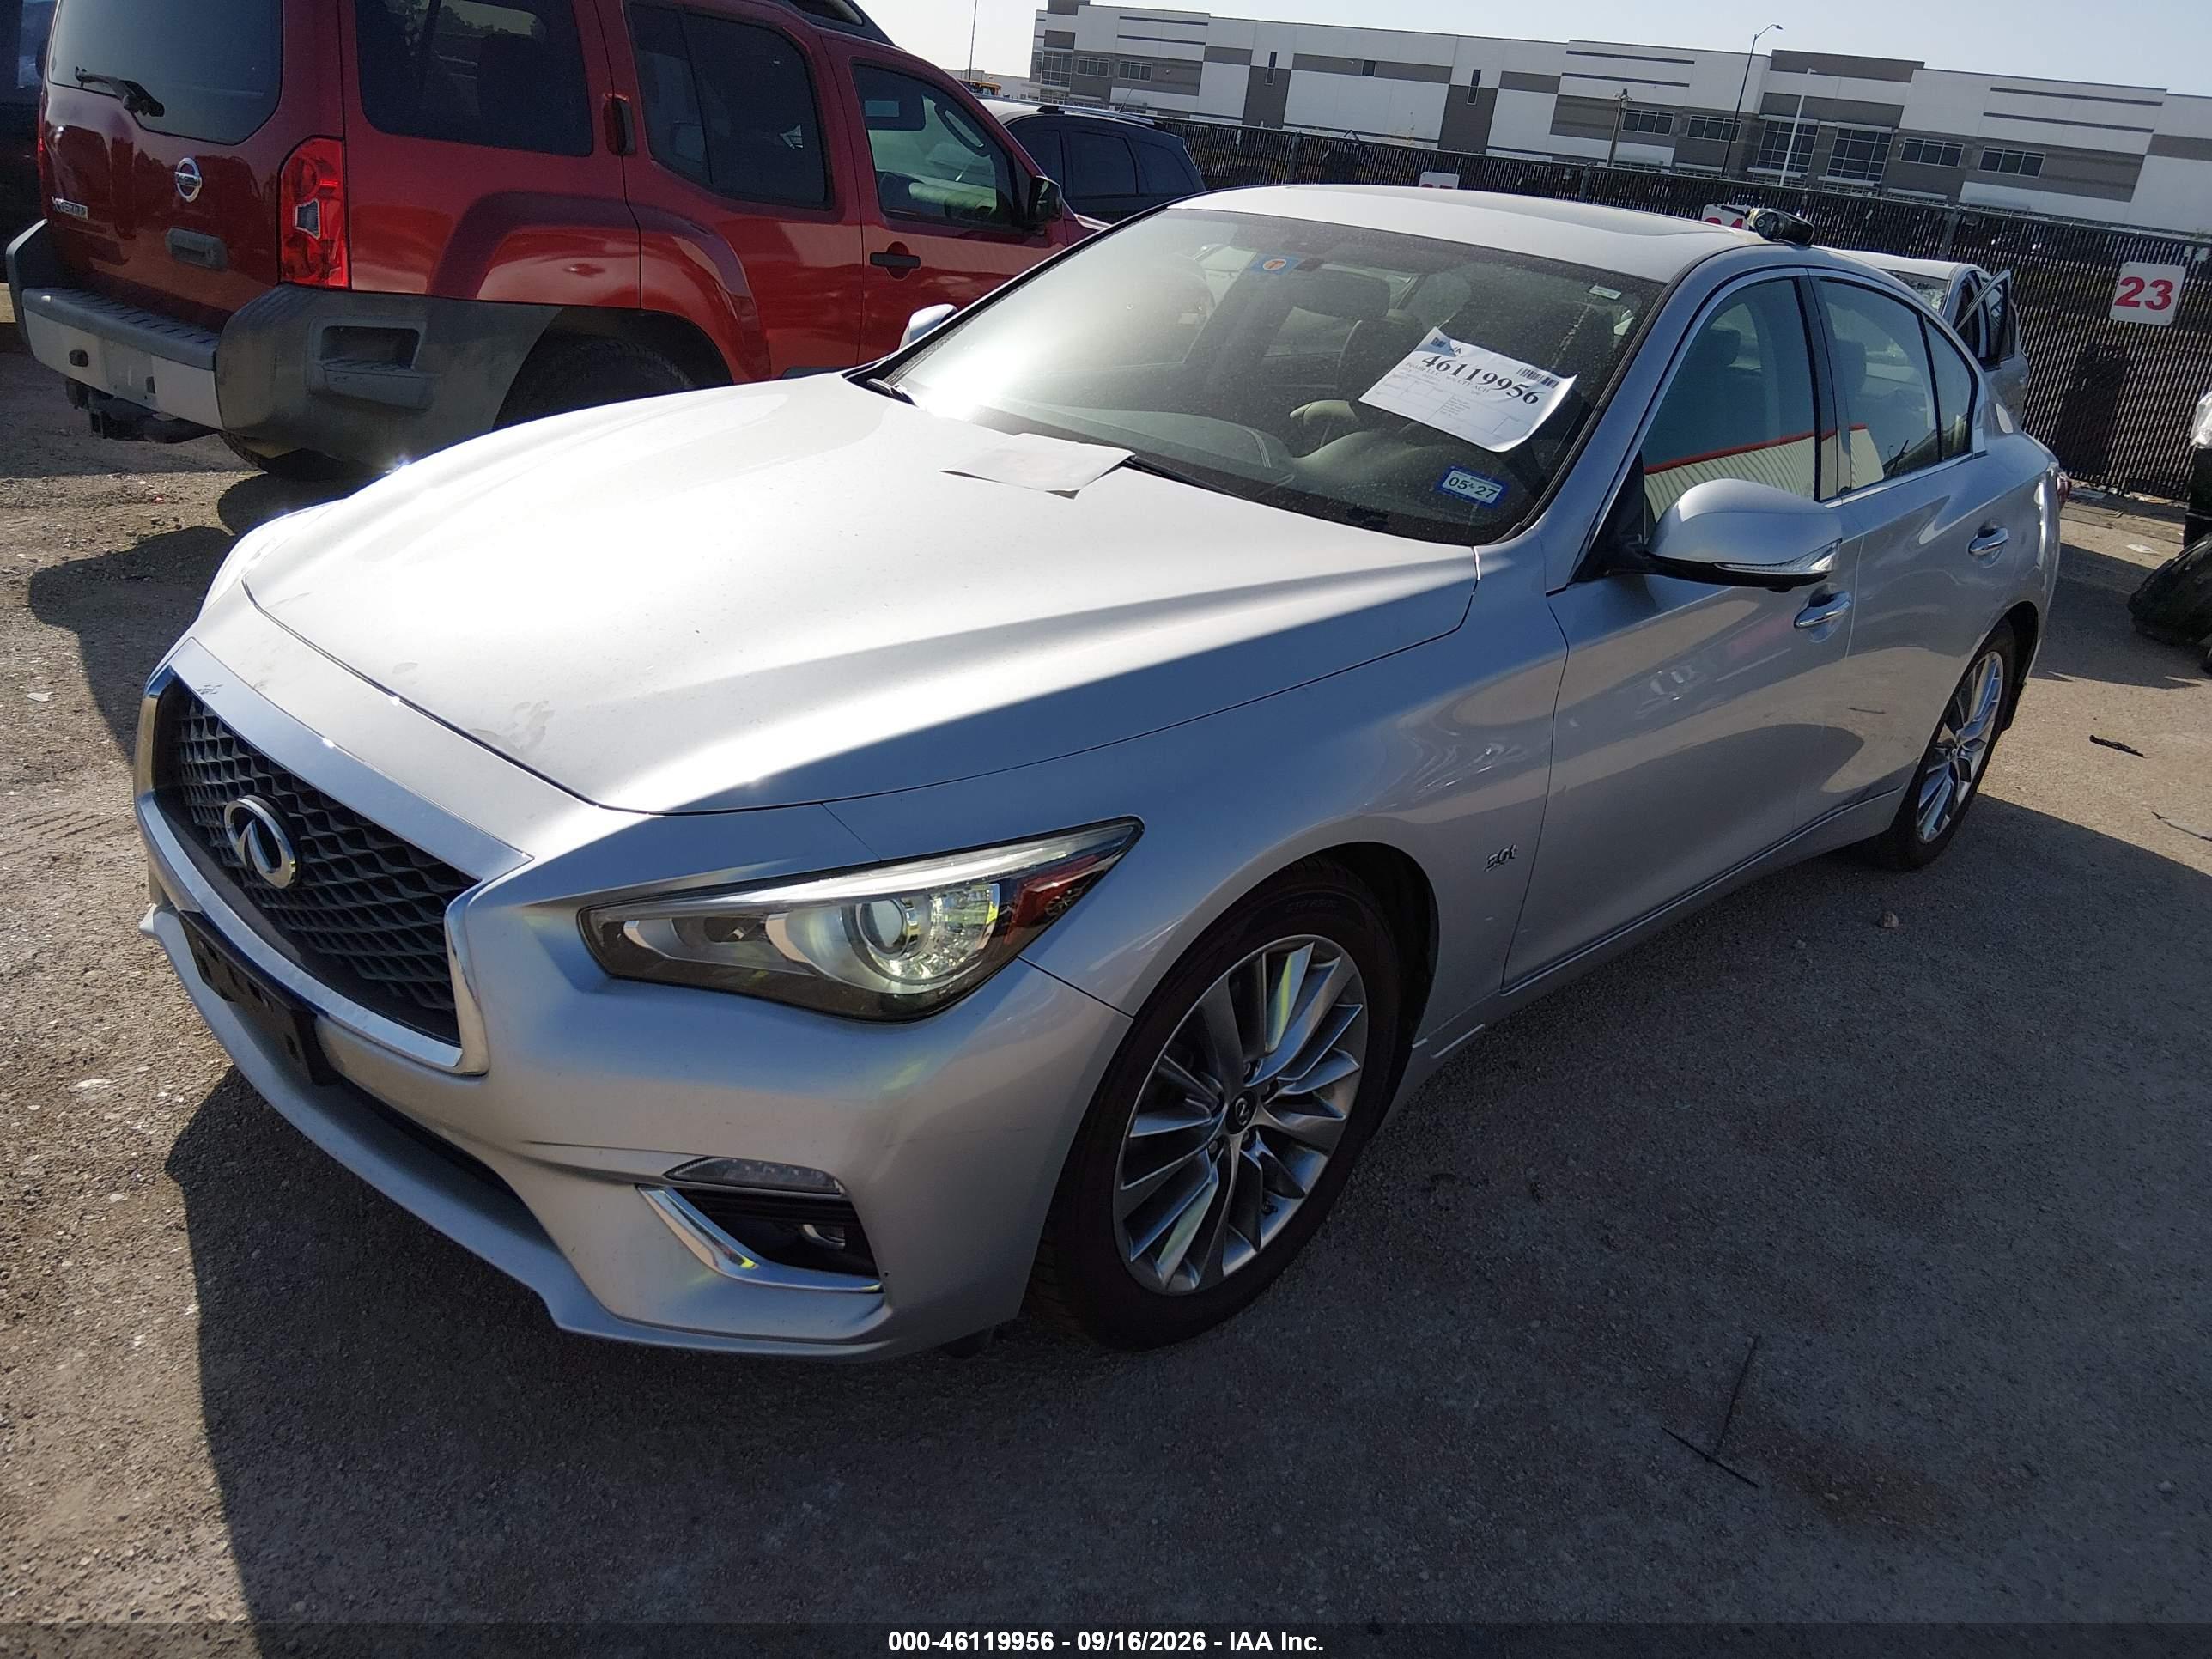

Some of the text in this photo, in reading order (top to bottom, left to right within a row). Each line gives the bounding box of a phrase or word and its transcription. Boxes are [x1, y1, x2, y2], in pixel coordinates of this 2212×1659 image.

[2113, 276, 2173, 311] 23
[1421, 355, 1545, 404] 46119956
[1448, 477, 1470, 489] 05
[1474, 485, 1498, 499] 27
